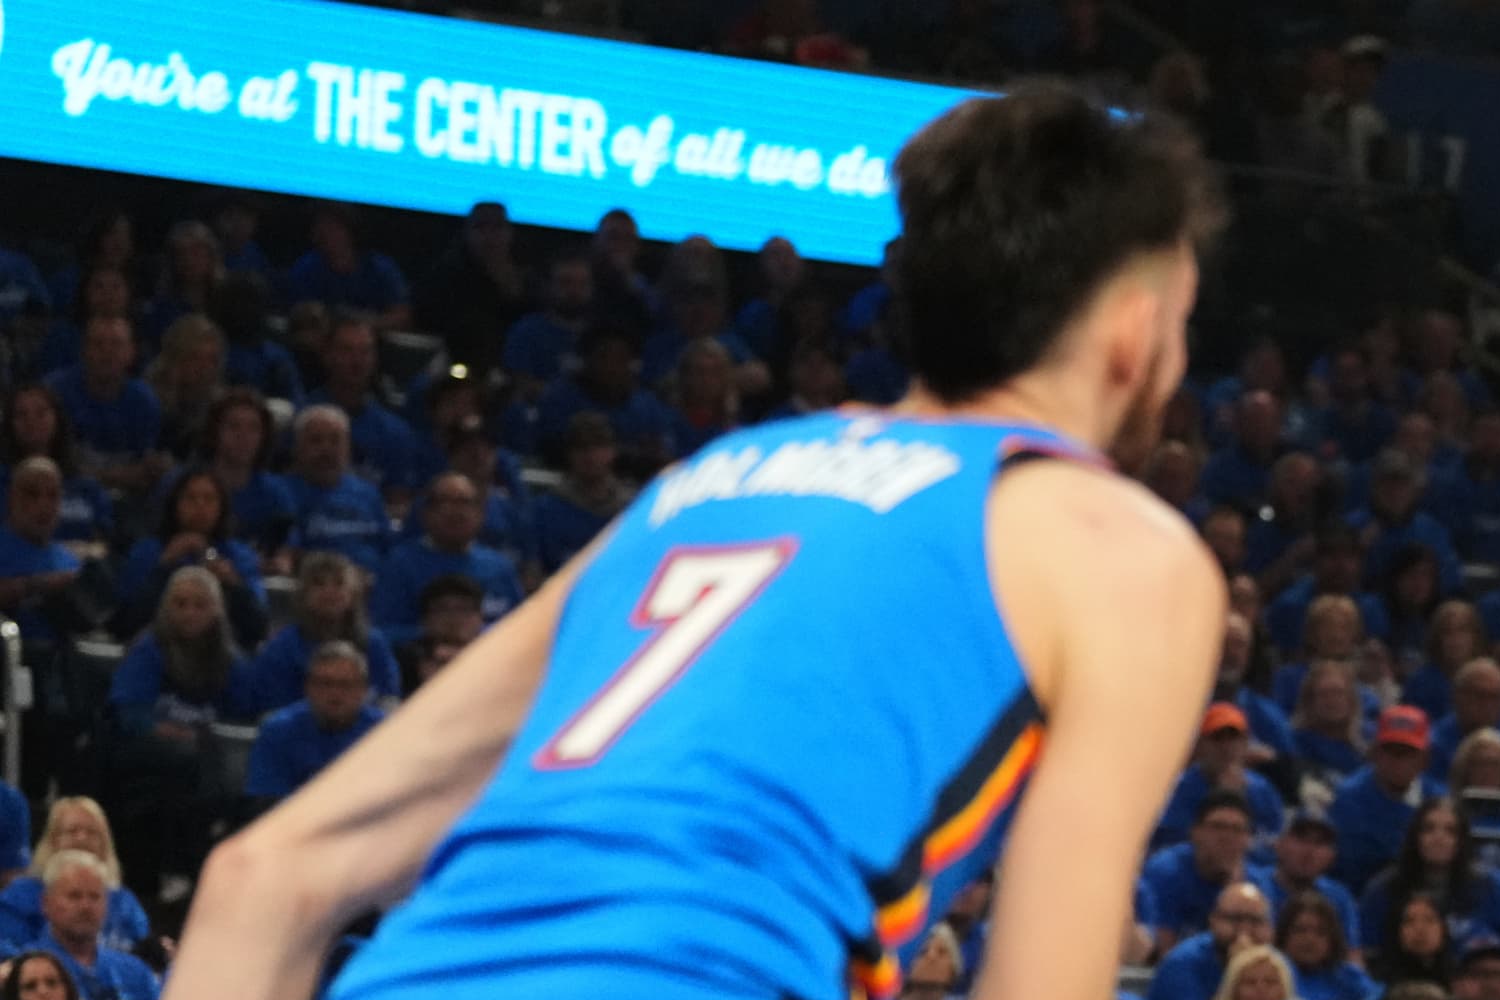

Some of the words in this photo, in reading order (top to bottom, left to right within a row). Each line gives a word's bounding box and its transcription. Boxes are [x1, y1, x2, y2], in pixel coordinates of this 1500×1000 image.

[52, 38, 230, 116] You're
[238, 69, 299, 122] at
[307, 61, 406, 153] THE
[413, 77, 606, 180] CENTER
[610, 114, 674, 187] of
[675, 127, 746, 181] all
[748, 141, 823, 191] we
[828, 145, 890, 198] do
[532, 532, 800, 771] 7
